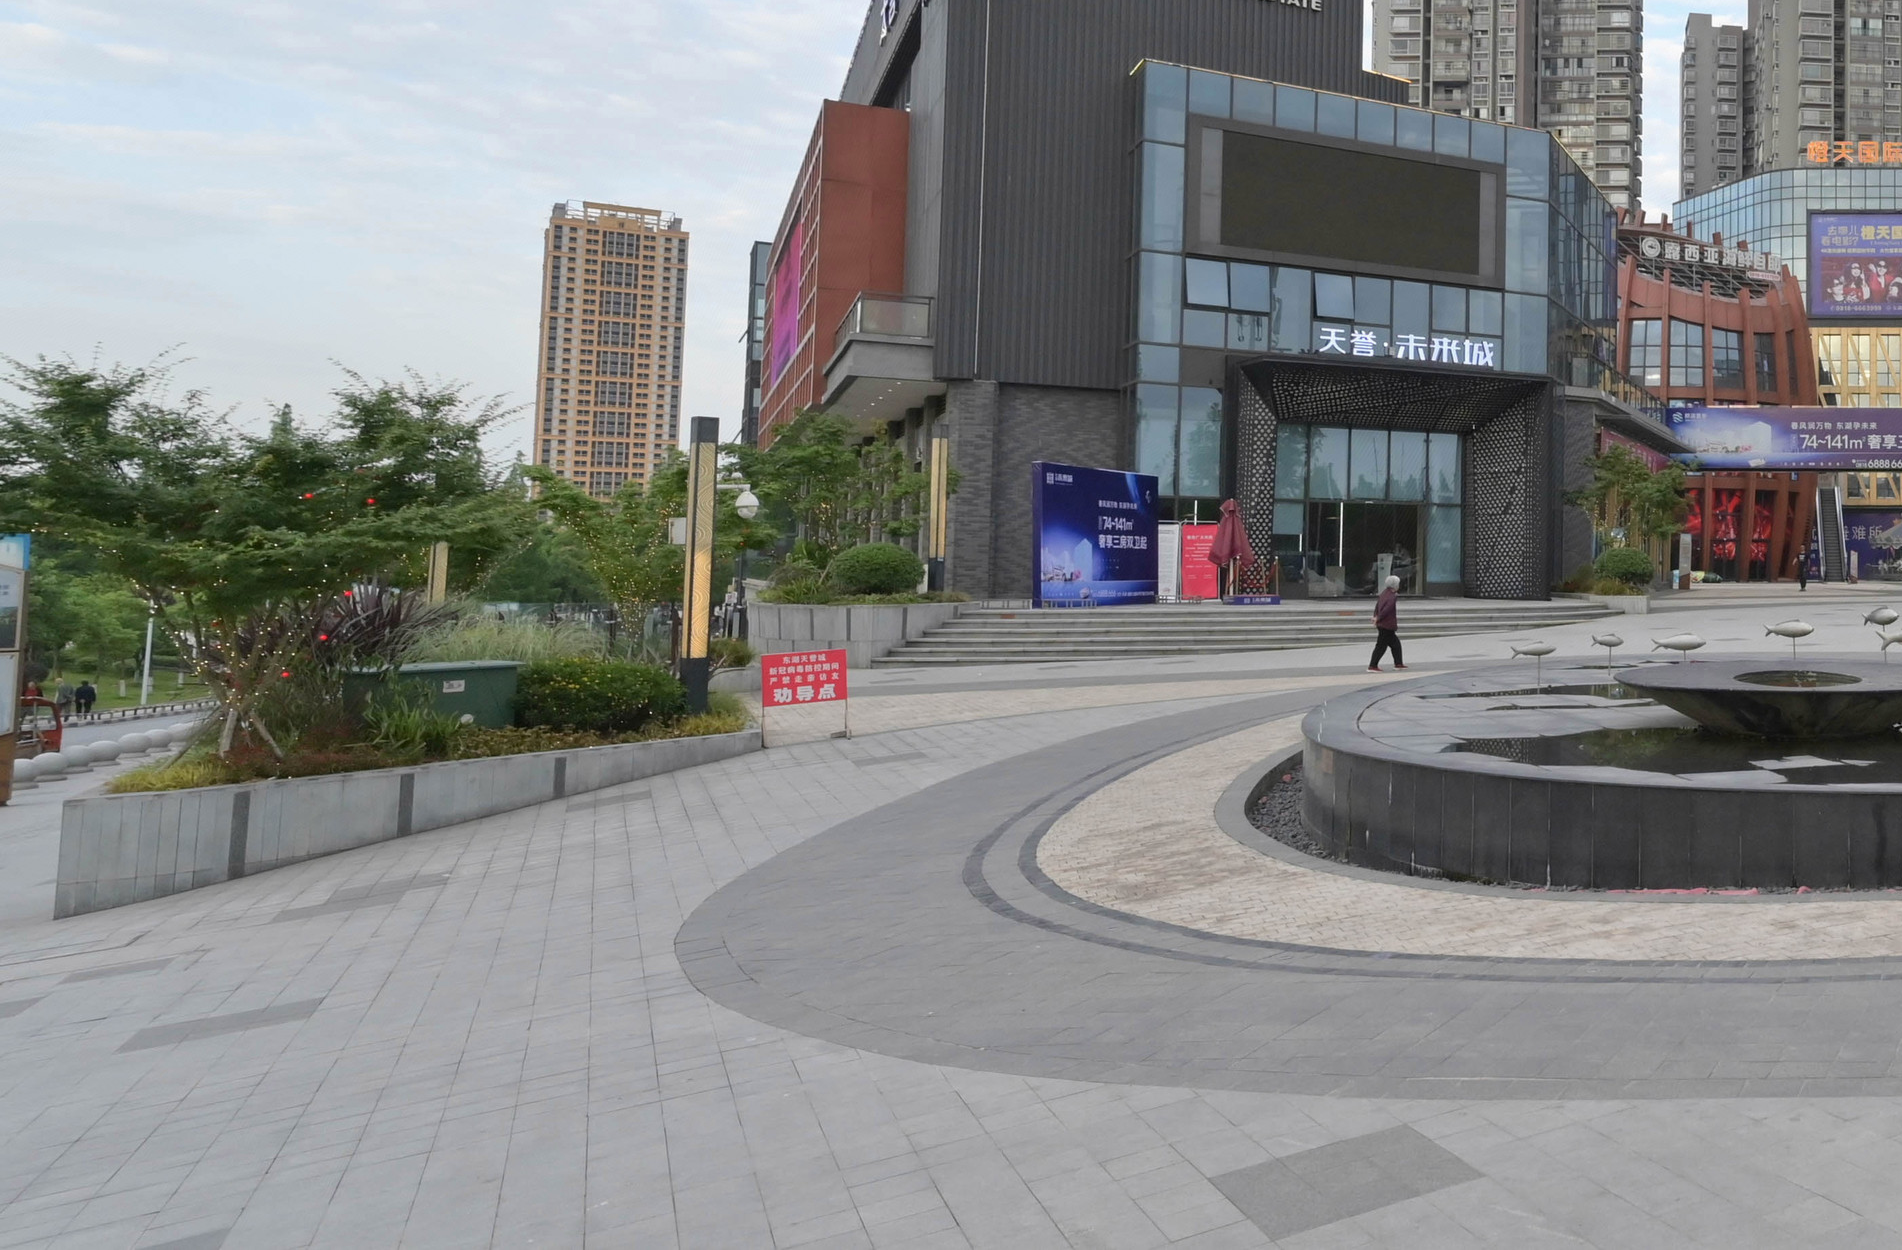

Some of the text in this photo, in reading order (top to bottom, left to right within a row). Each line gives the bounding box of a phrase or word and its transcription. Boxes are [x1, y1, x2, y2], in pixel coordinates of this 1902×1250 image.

[1319, 327, 1494, 367] 天誉·未来城
[773, 683, 836, 703] 劝导点
